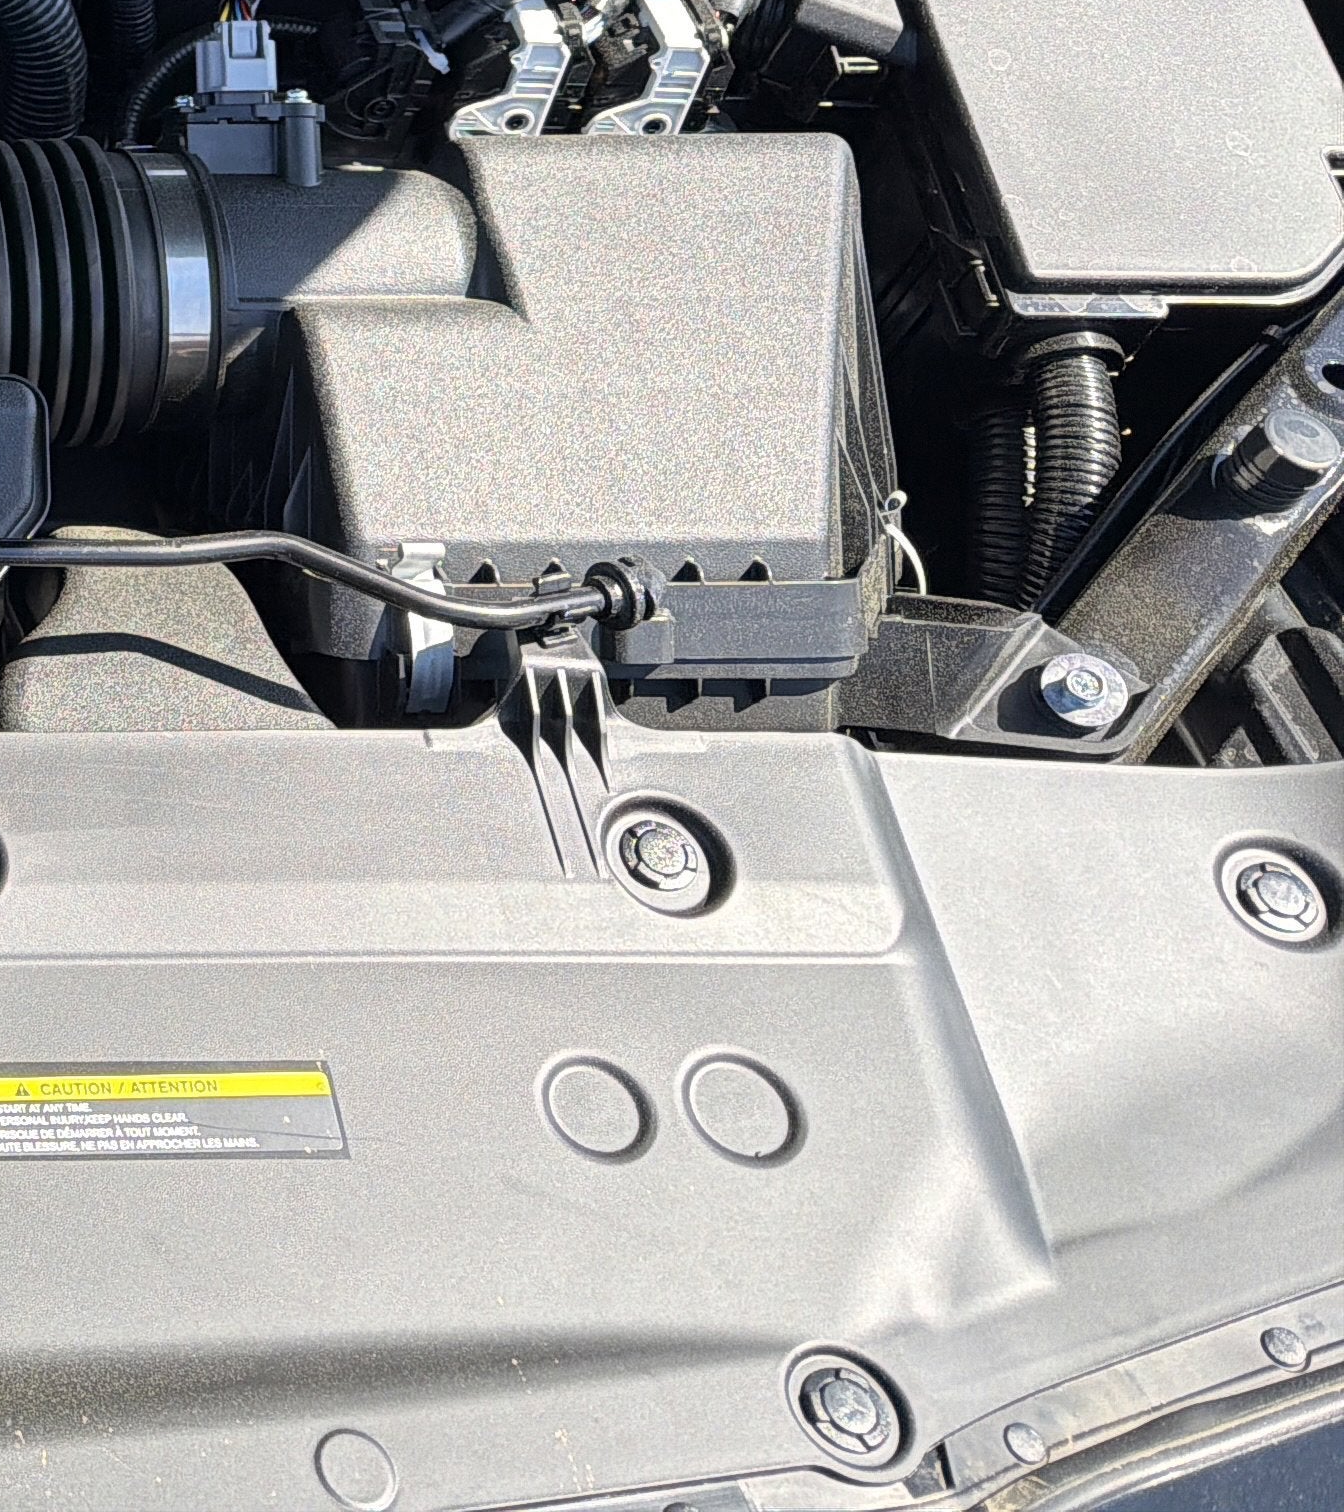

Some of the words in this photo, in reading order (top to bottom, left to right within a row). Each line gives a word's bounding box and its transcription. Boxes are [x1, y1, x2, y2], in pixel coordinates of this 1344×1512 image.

[40, 1082, 112, 1096] CAUTION
[130, 1079, 218, 1094] ATTENTION
[27, 1104, 41, 1114] AT
[42, 1103, 64, 1113] ANY
[113, 1113, 150, 1124] HANDS
[0, 1128, 39, 1140] RISQUE
[40, 1128, 55, 1139] DE
[124, 1126, 152, 1137] TOUT
[81, 1141, 96, 1151] NE
[97, 1140, 118, 1151] PAS
[119, 1140, 136, 1151] EN
[136, 1138, 201, 1150] APPROCHER
[202, 1138, 223, 1149] LES
